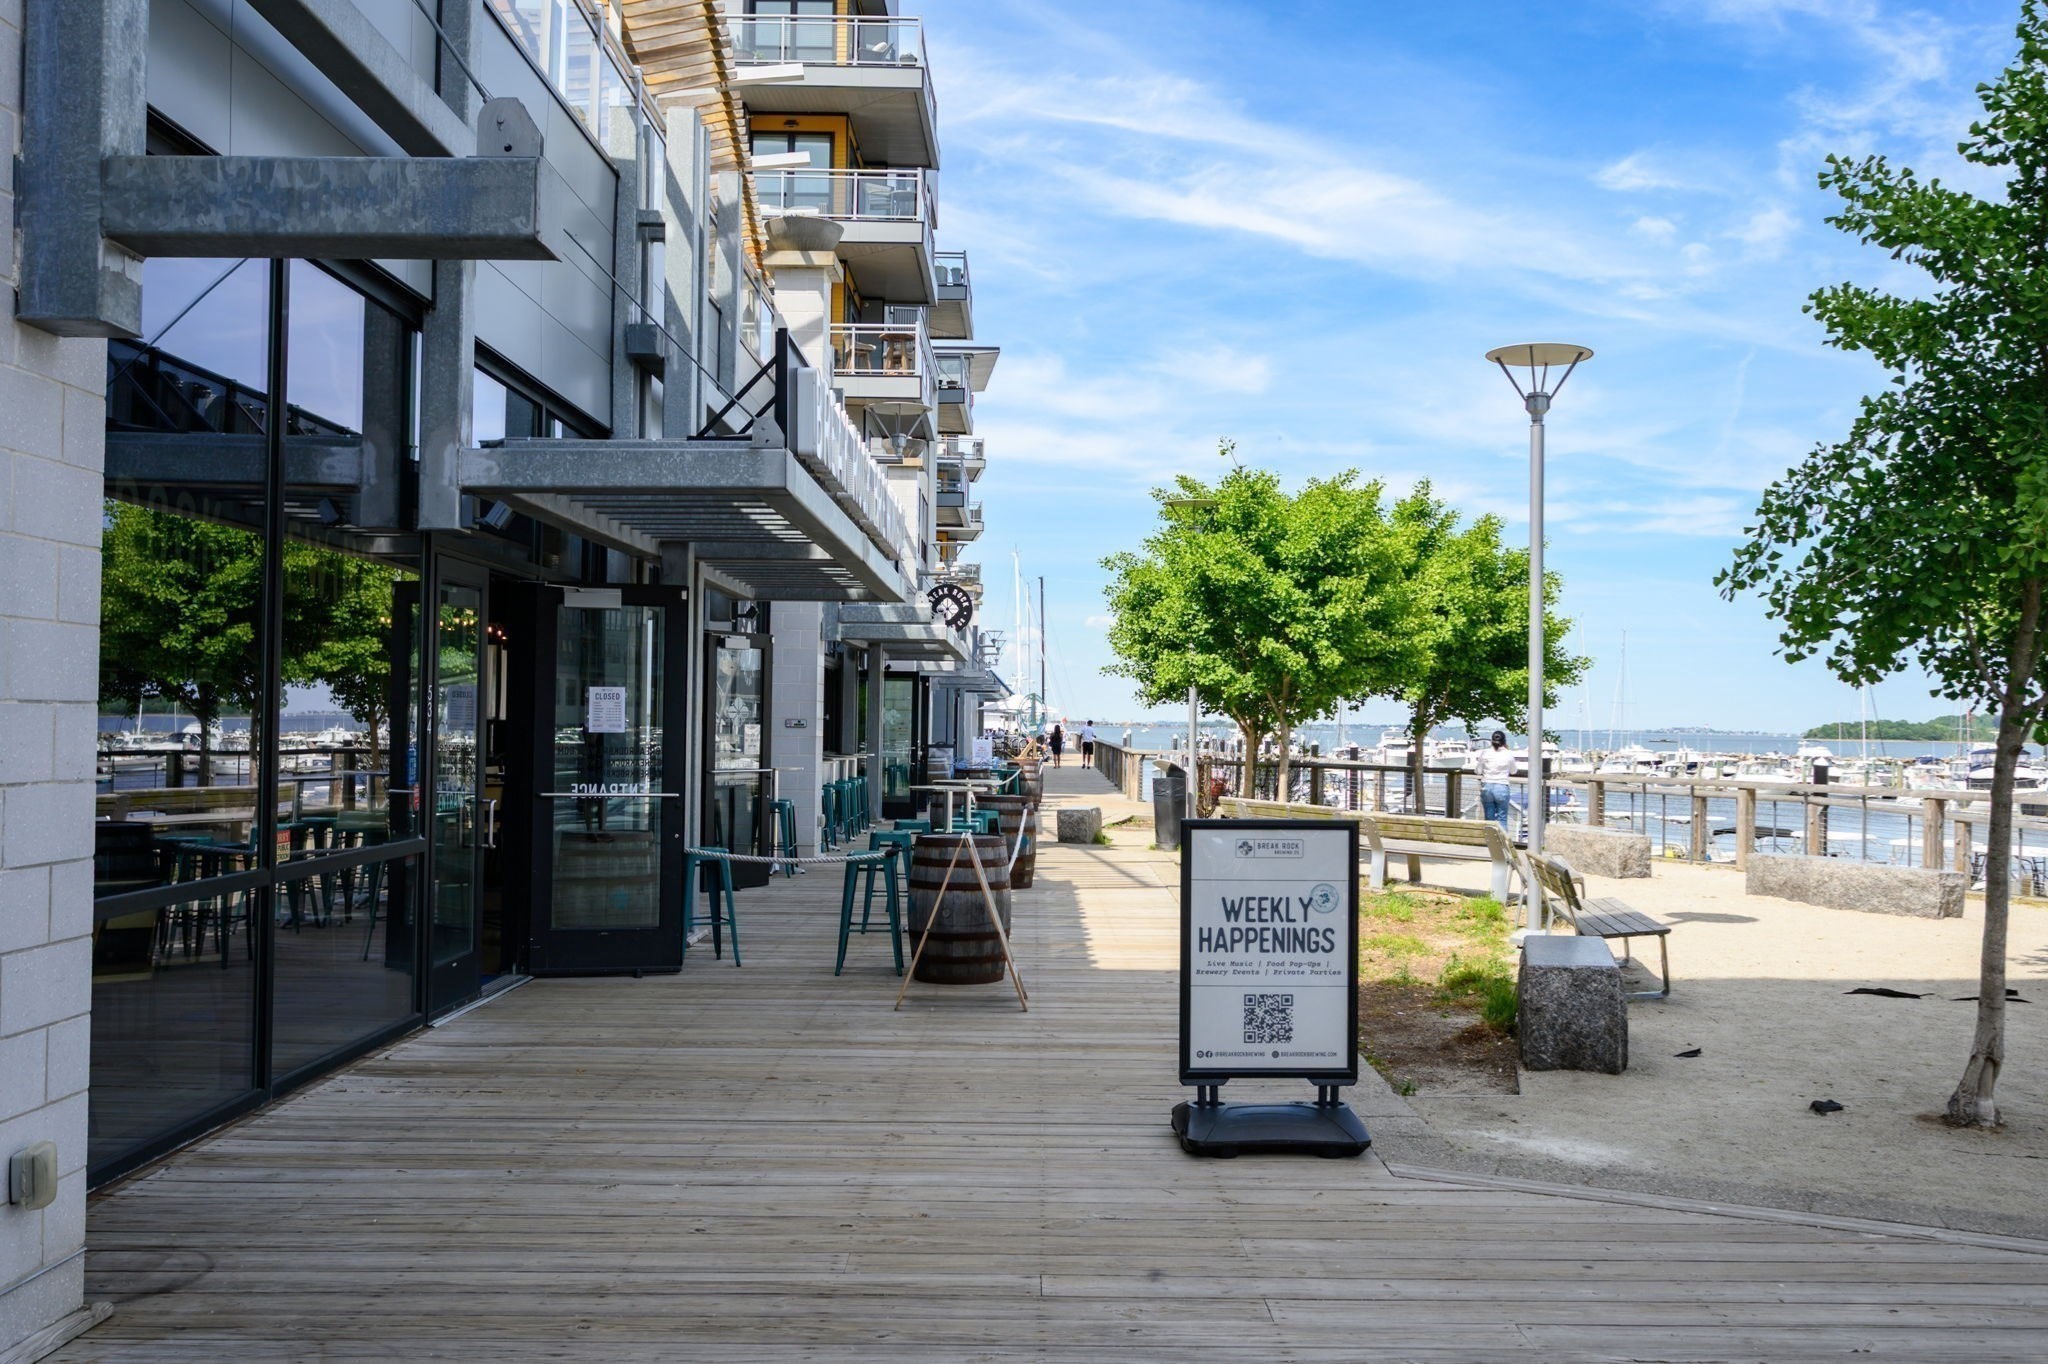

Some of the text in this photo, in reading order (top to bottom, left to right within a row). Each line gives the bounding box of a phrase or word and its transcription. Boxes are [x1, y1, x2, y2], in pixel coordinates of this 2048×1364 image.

[952, 588, 970, 608] ROCK
[594, 692, 621, 701] CLOSED
[1257, 842, 1300, 850] BREAK ROCK
[1221, 896, 1313, 923] WEEKLY
[1198, 926, 1335, 954] HAPPENINGS
[1207, 960, 1226, 968] Live
[1288, 960, 1322, 969] Pop-Ups
[1195, 969, 1229, 977] Brewery
